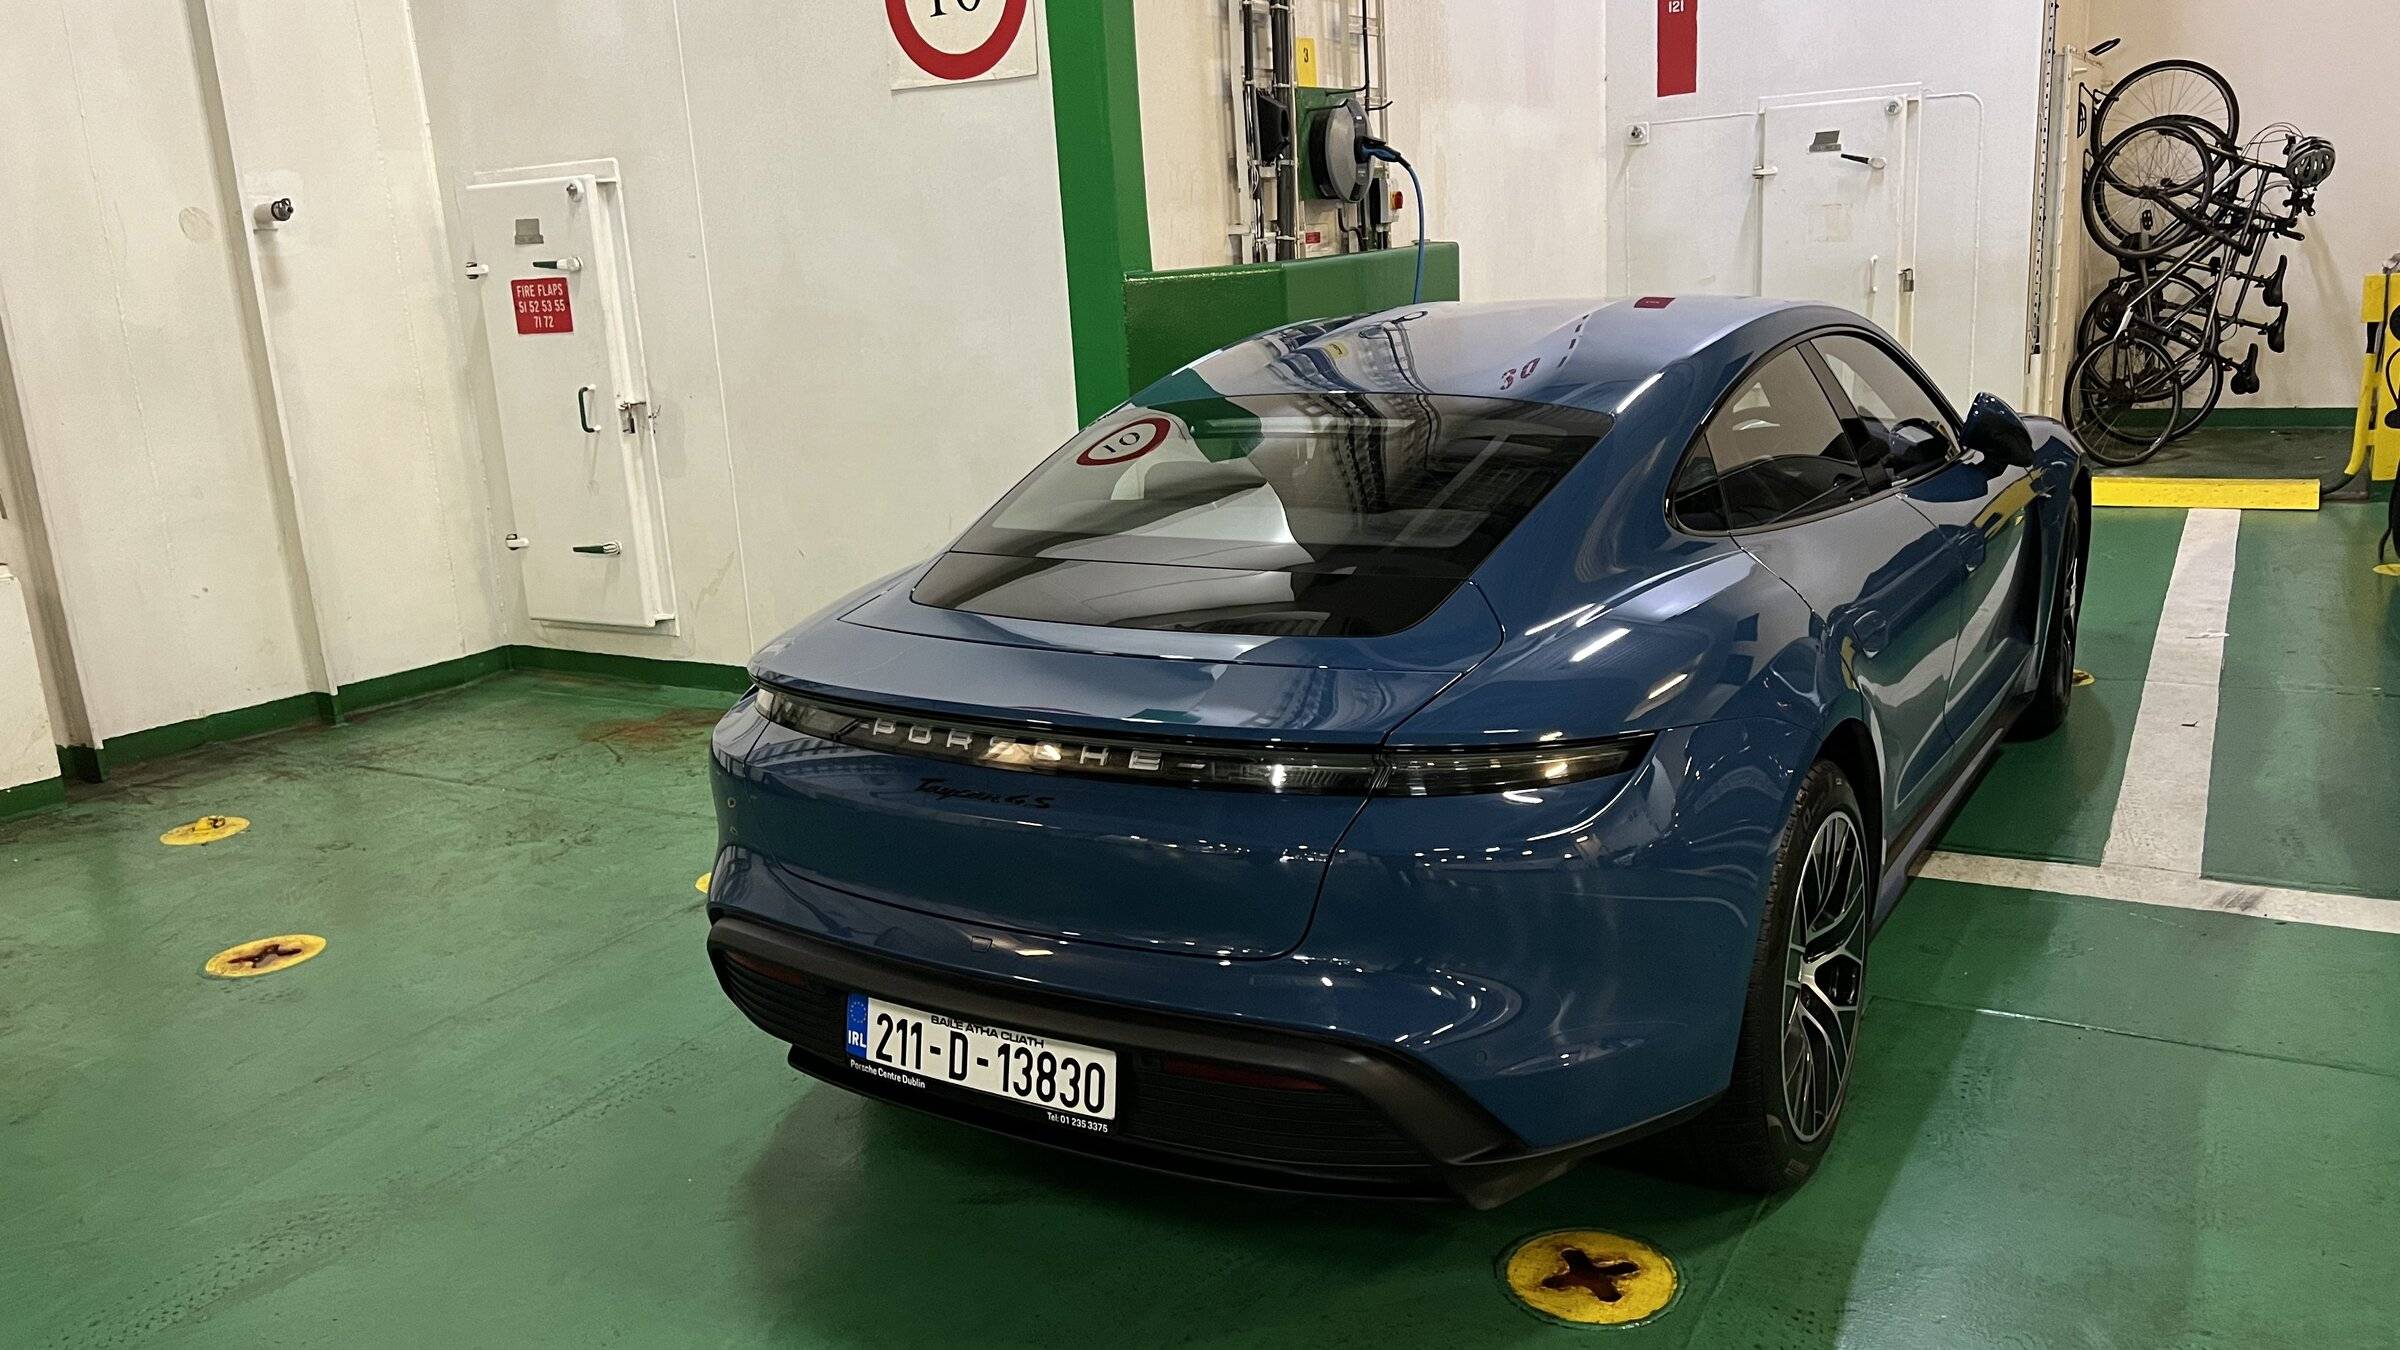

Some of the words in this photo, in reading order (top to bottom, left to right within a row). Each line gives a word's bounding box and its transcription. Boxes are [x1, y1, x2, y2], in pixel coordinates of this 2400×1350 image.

[1668, 0, 1684, 13] 121
[1303, 47, 1309, 63] 3
[516, 284, 536, 298] FIRE
[537, 282, 563, 297] FLAPS
[518, 301, 528, 314] 51
[528, 301, 540, 313] 52
[541, 300, 553, 312] 53
[554, 299, 566, 312] 55
[533, 316, 542, 328] 71
[543, 316, 555, 328] 72
[847, 1029, 867, 1049] IRL
[930, 1014, 963, 1030] BAILE
[1000, 1031, 1045, 1049] CLIATH
[875, 1012, 1106, 1114] 211-D-13830
[850, 1059, 877, 1075] Porsche
[877, 1067, 902, 1083] Centre
[902, 1074, 926, 1089] Dublin
[1060, 1114, 1070, 1125] 01
[1071, 1117, 1087, 1129] 235
[1087, 1120, 1108, 1133] 3375
